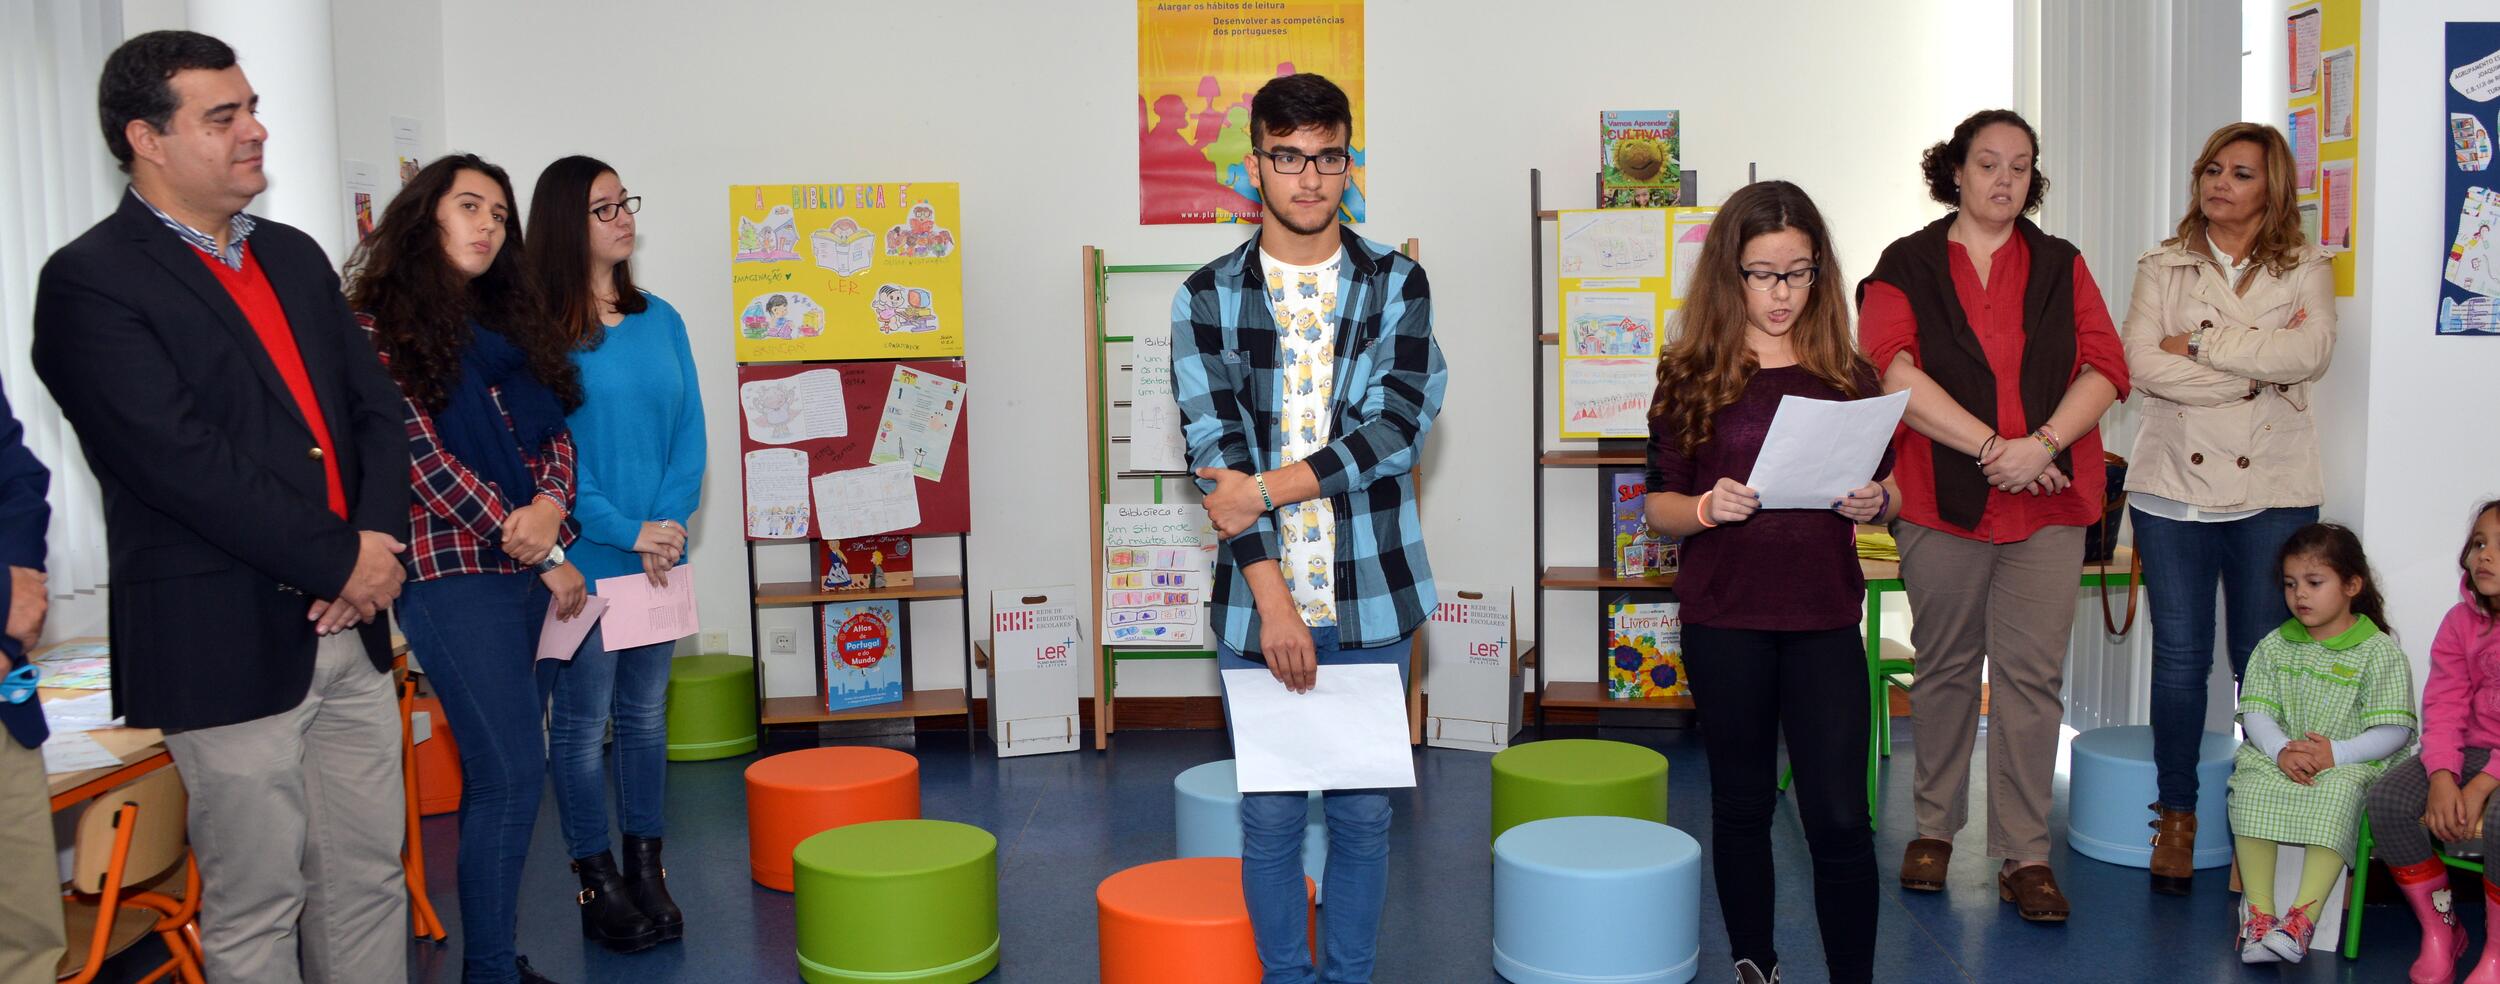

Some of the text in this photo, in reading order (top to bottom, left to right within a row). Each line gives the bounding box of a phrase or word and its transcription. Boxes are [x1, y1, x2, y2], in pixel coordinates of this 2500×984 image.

[1157, 3, 1191, 12] Alargar
[1206, 1, 1240, 10] hábitos
[1242, 1, 1253, 10] de
[1255, 1, 1286, 10] leitura
[1213, 16, 1268, 25] Desenvolver
[1283, 15, 1345, 26] competências
[1213, 27, 1288, 37] dos portugueses
[1634, 120, 1667, 128] Aprender
[828, 278, 860, 296] LER
[1036, 614, 1075, 622] BIBLIOTECAS
[1470, 611, 1509, 620] BIBLIOTECAS
[1036, 621, 1071, 629] ESCOLARES
[1470, 618, 1505, 627] ESCOLARES
[1621, 615, 1650, 629] Livro
[846, 638, 881, 651] Portugal
[851, 656, 876, 665] Mundo
